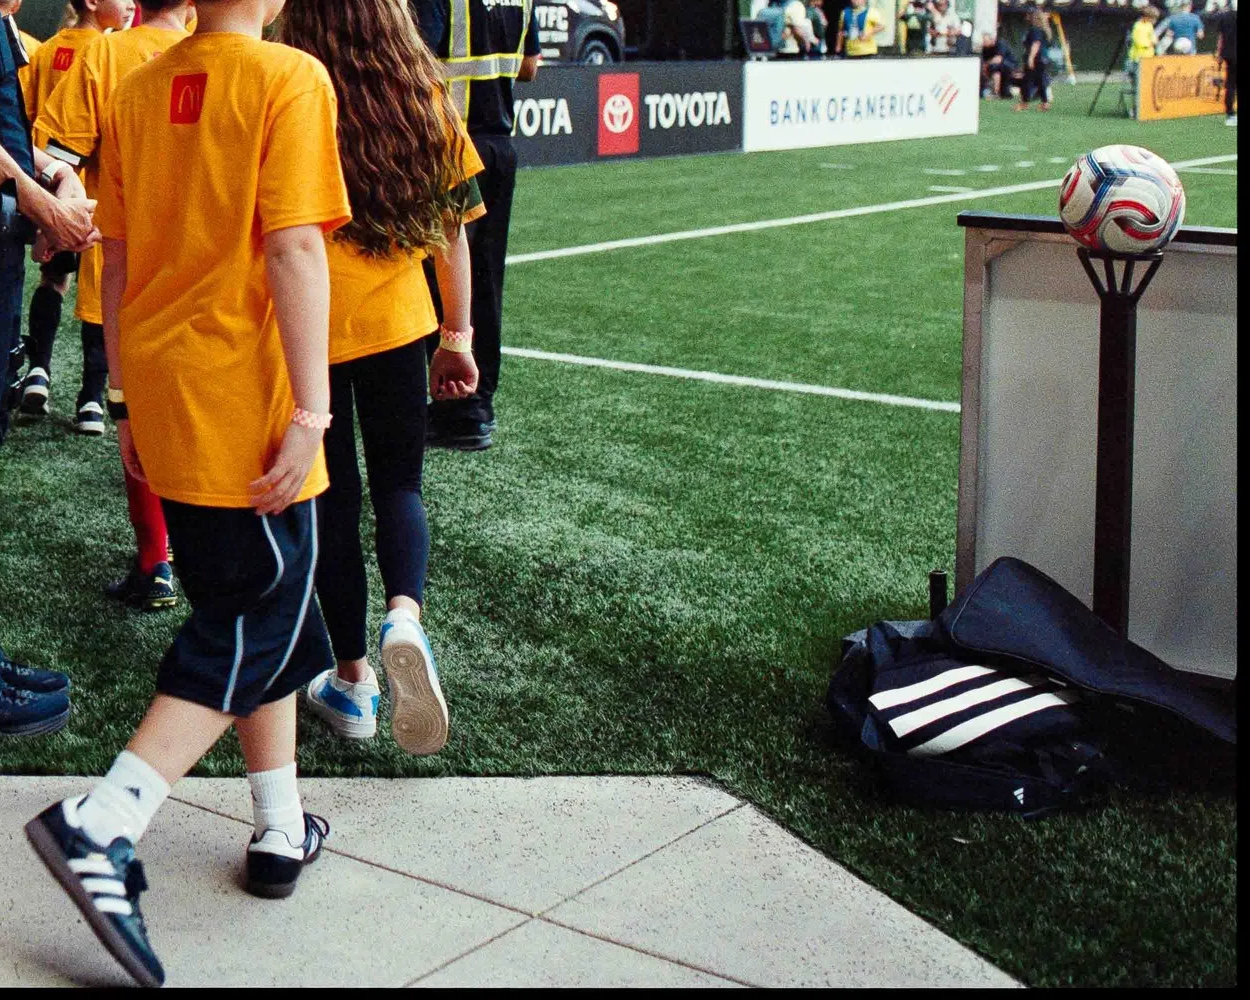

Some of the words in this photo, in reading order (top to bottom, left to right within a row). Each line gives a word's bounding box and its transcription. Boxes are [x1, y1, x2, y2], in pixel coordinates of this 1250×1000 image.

[644, 91, 732, 129] TOYOTA
[770, 99, 821, 126] BANK
[827, 96, 850, 121] OF
[853, 92, 927, 121] AMERICA
